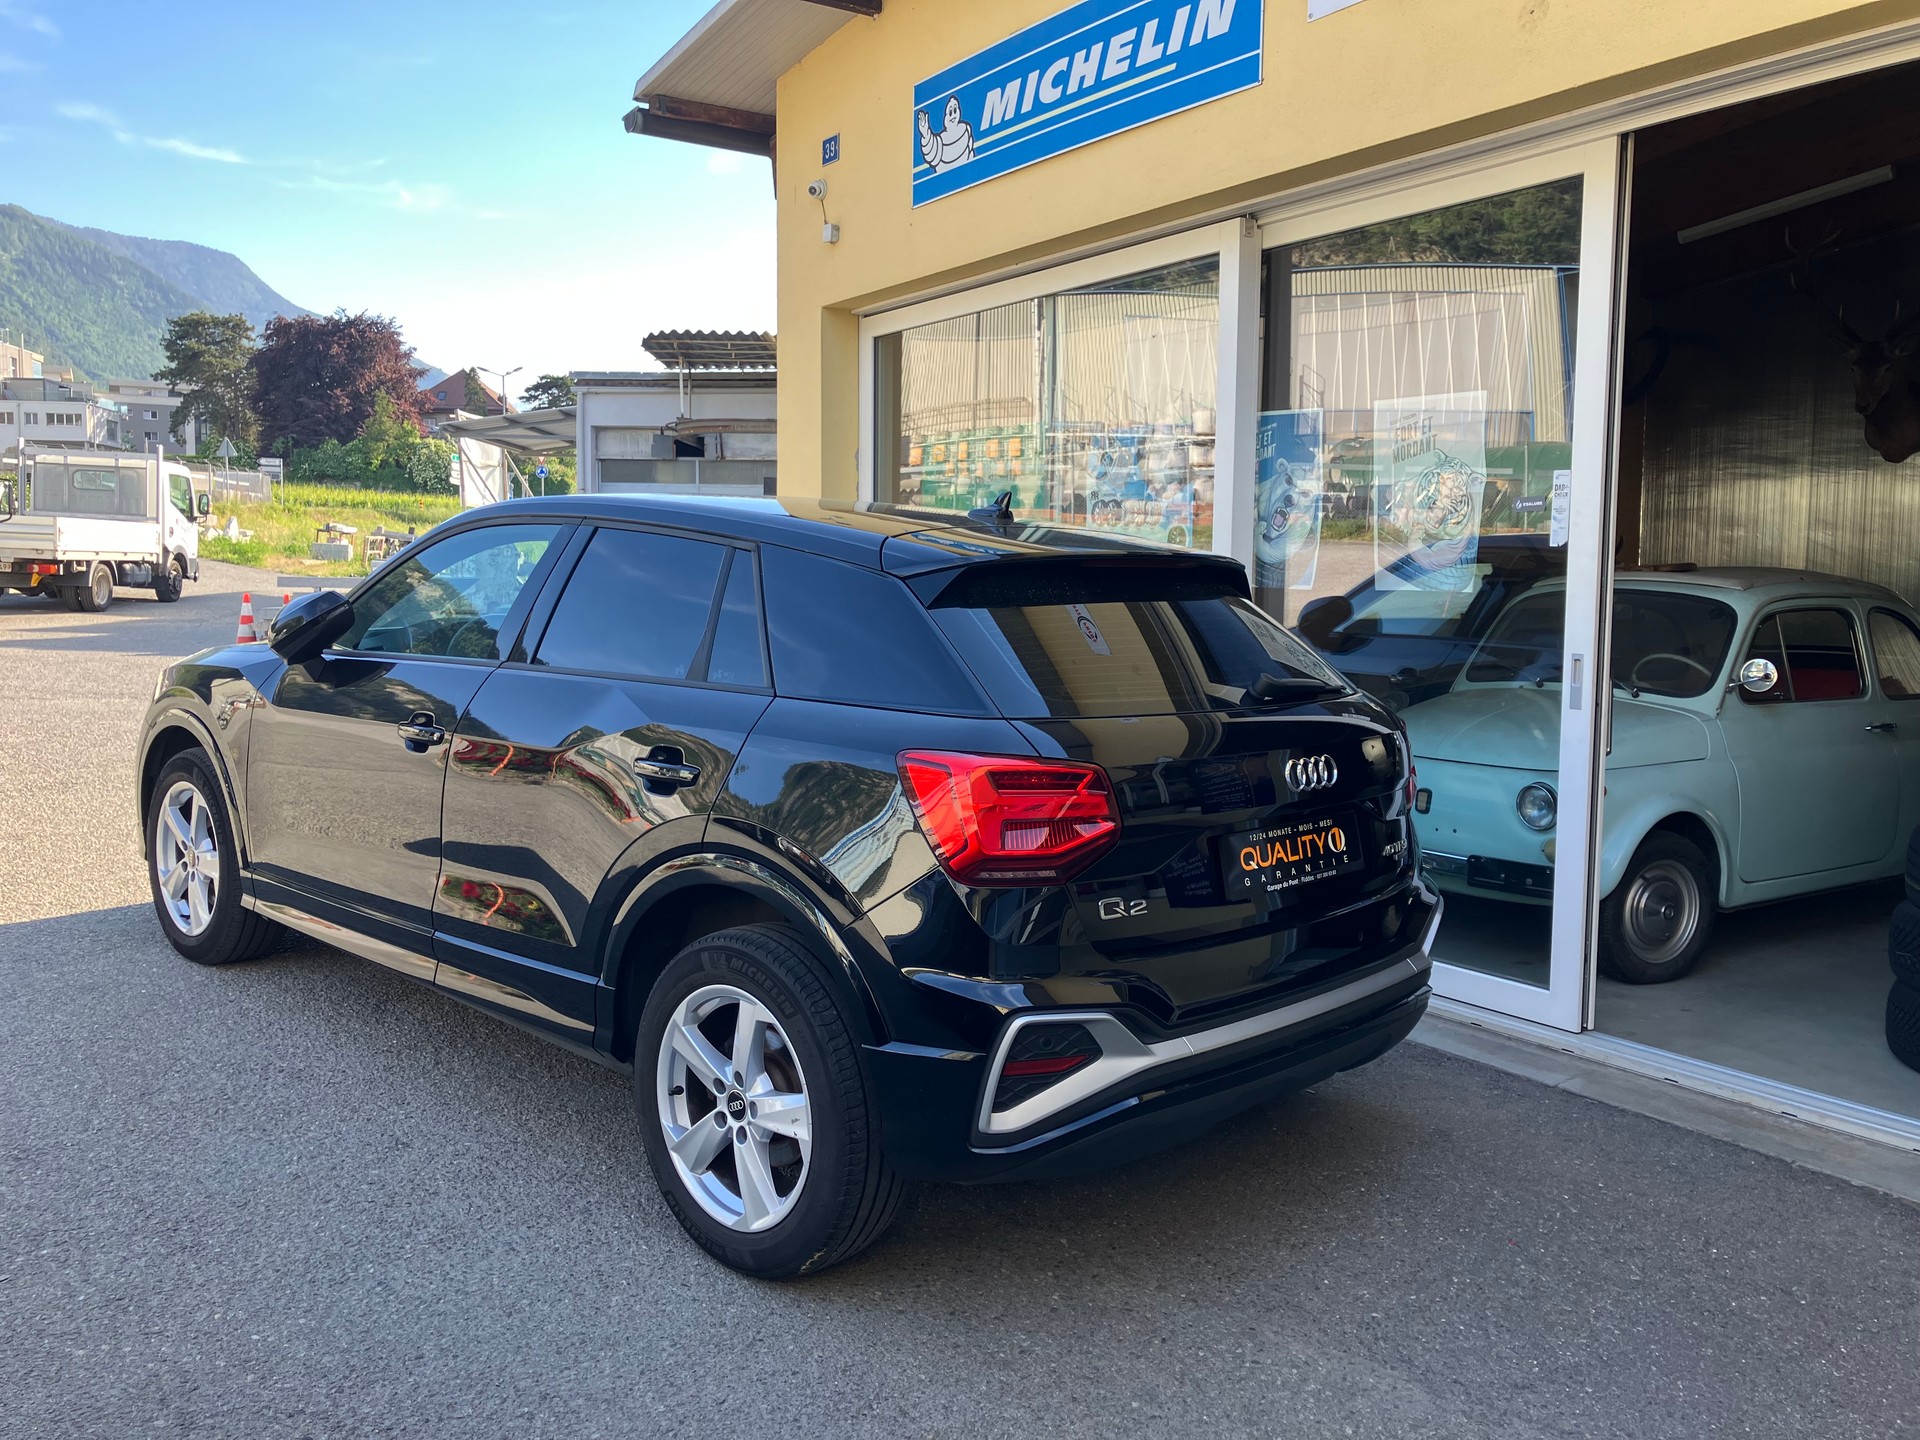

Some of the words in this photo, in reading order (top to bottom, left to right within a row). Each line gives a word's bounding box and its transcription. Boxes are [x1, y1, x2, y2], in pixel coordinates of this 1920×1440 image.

[980, 0, 1236, 131] MICHELIN
[825, 140, 835, 159] 39
[1263, 430, 1272, 446] ET
[1394, 420, 1419, 445] FORT
[1421, 415, 1433, 435] ET
[1392, 434, 1438, 464] MORDANT
[1250, 833, 1266, 842] 12/24
[1268, 828, 1292, 838] MONATE
[1298, 823, 1313, 832] MOIS
[1320, 819, 1333, 828] MESI
[1240, 832, 1326, 871] QUALITY
[1244, 854, 1349, 888] GARANTIE
[1266, 882, 1282, 892] Garage
[1282, 880, 1288, 888] du
[1288, 878, 1299, 887] Pont
[1098, 896, 1148, 921] Q2
[729, 957, 795, 1017] MICHELIN
